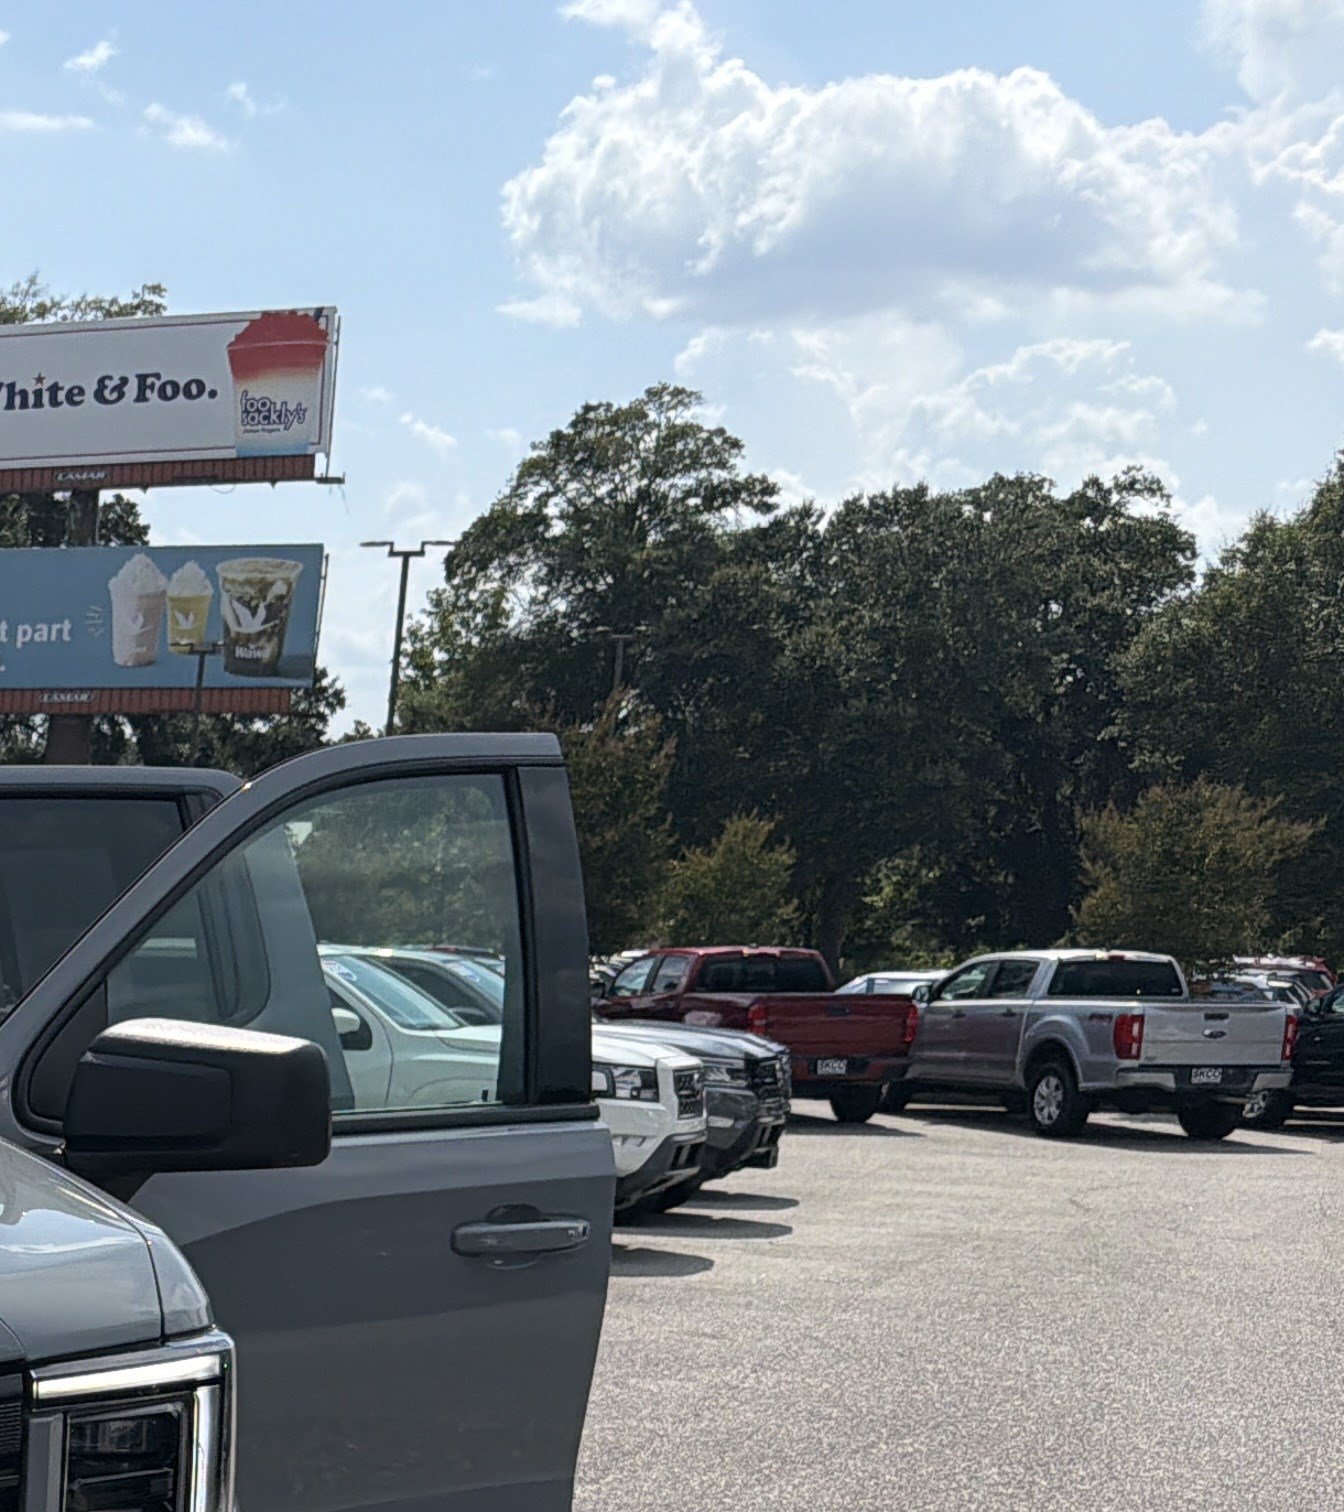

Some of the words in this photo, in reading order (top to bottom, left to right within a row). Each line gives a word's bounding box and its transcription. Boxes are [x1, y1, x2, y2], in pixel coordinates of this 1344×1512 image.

[93, 374, 130, 405] &
[133, 372, 218, 403] Foo.
[15, 618, 72, 649] part
